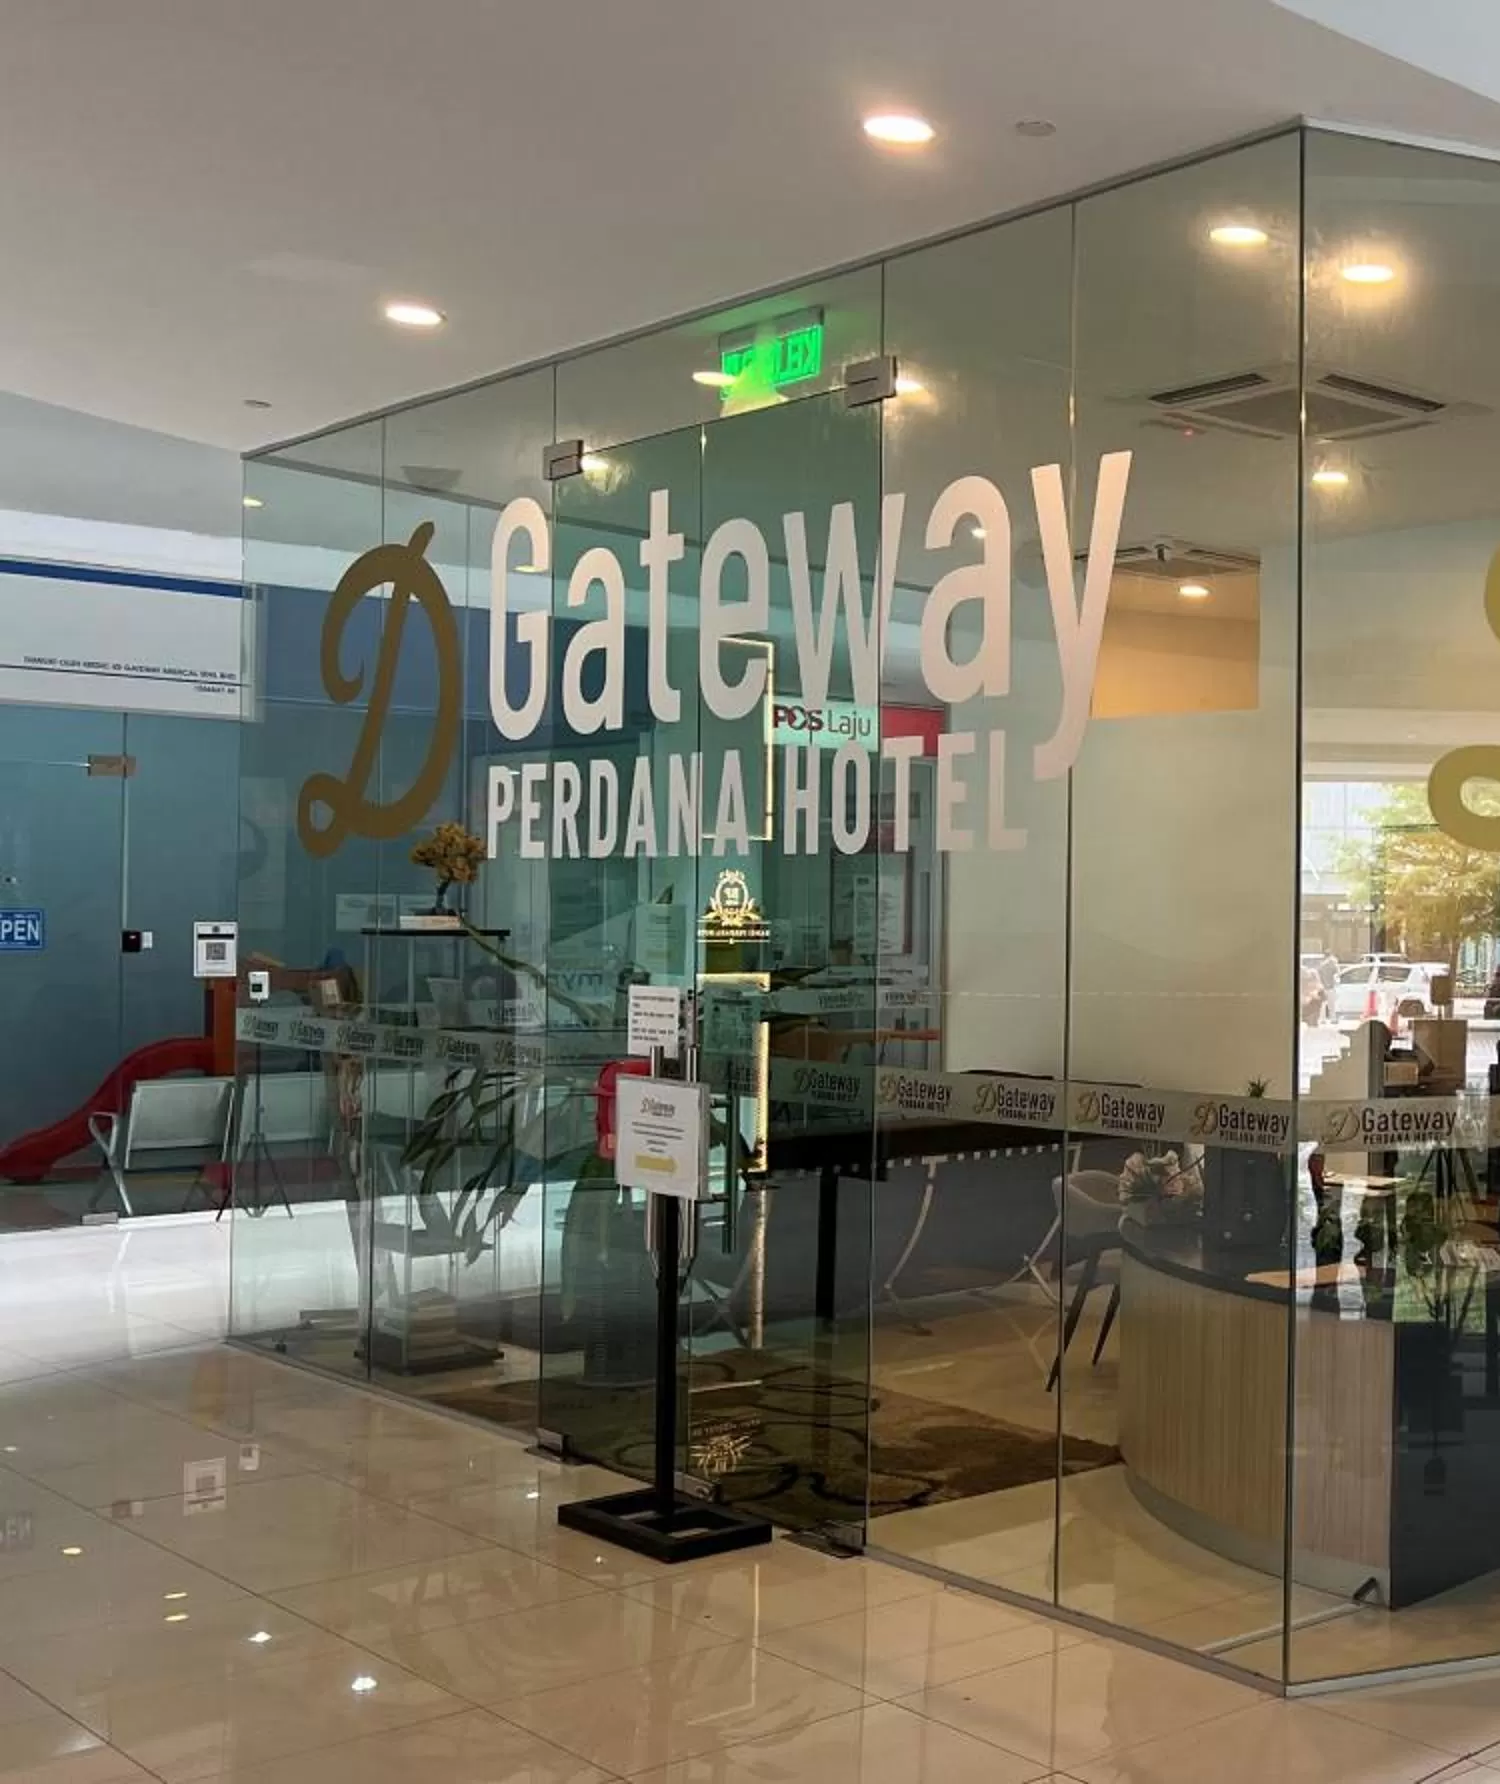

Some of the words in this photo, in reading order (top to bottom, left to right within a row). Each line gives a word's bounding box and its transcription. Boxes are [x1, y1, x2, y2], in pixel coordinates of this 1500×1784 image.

[297, 521, 459, 858] D
[488, 450, 1133, 781] Gateway
[827, 708, 872, 740] Laju
[486, 749, 750, 859] PERDANA
[784, 730, 1028, 856] HOTEL
[0, 919, 40, 941] PEN
[810, 1068, 861, 1098] Gateway
[899, 1076, 952, 1102] Gateway
[998, 1085, 1055, 1117] Gateway
[1100, 1092, 1165, 1128] Gateway
[1218, 1103, 1291, 1140] Gateway
[1361, 1107, 1457, 1137] Gateway
